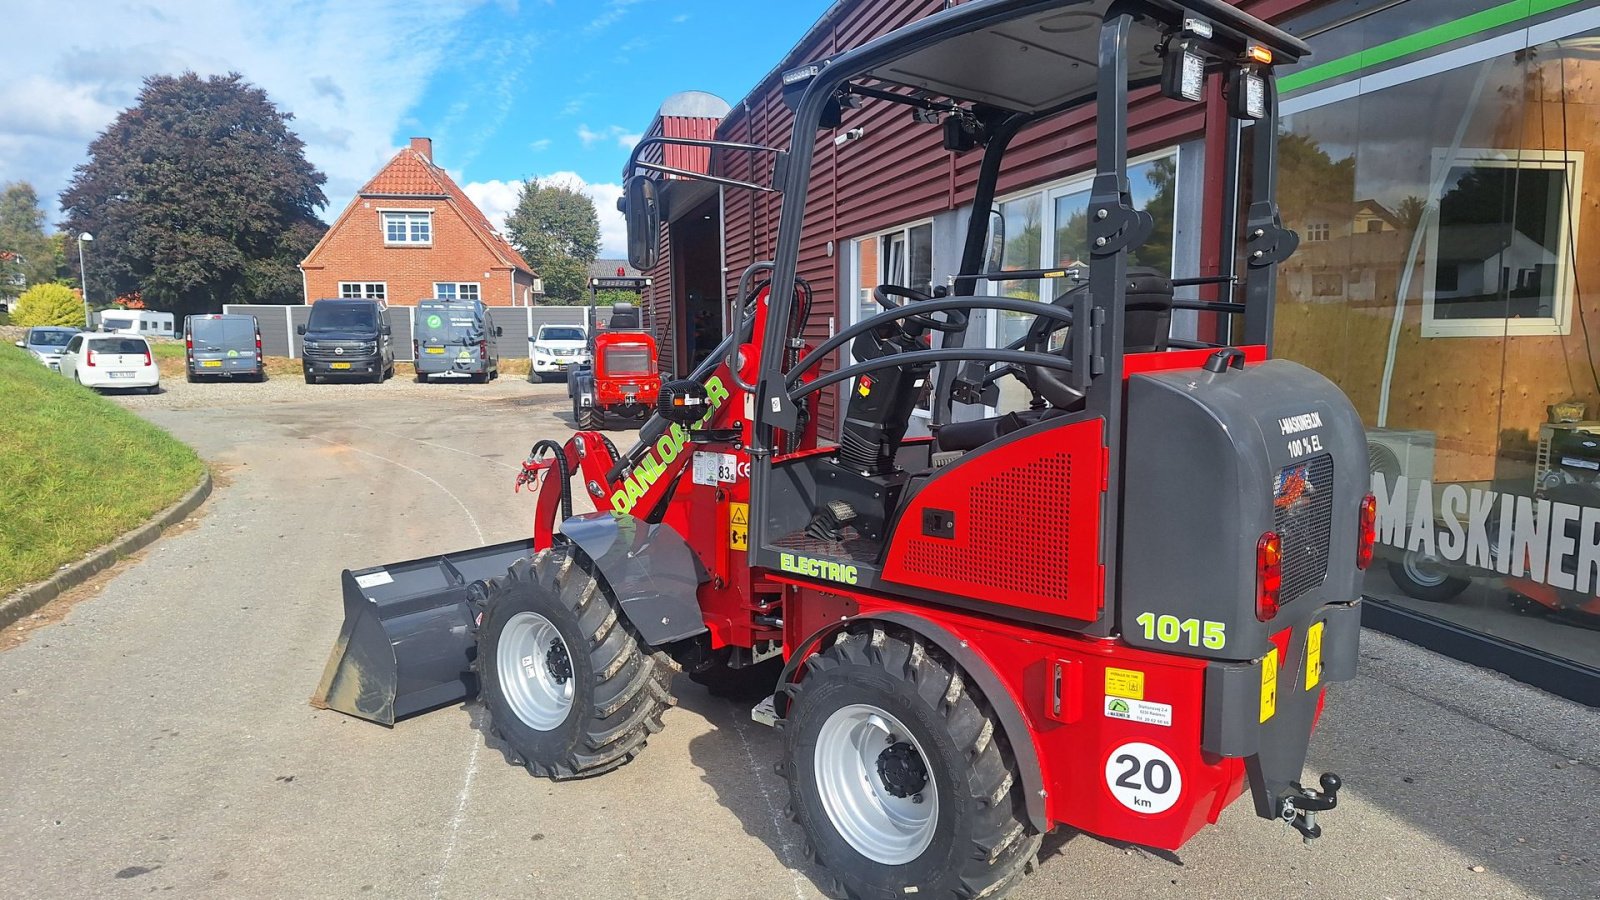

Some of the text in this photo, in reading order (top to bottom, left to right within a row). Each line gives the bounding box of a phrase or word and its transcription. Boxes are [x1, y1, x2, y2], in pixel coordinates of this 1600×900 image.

[610, 375, 730, 514] DANLOAR
[1287, 434, 1324, 459] 100 % EL
[718, 465, 730, 480] 83
[780, 552, 858, 585] ELECTRIC
[1136, 612, 1226, 650] 1015
[1115, 753, 1172, 795] 20
[1133, 795, 1152, 809] km
